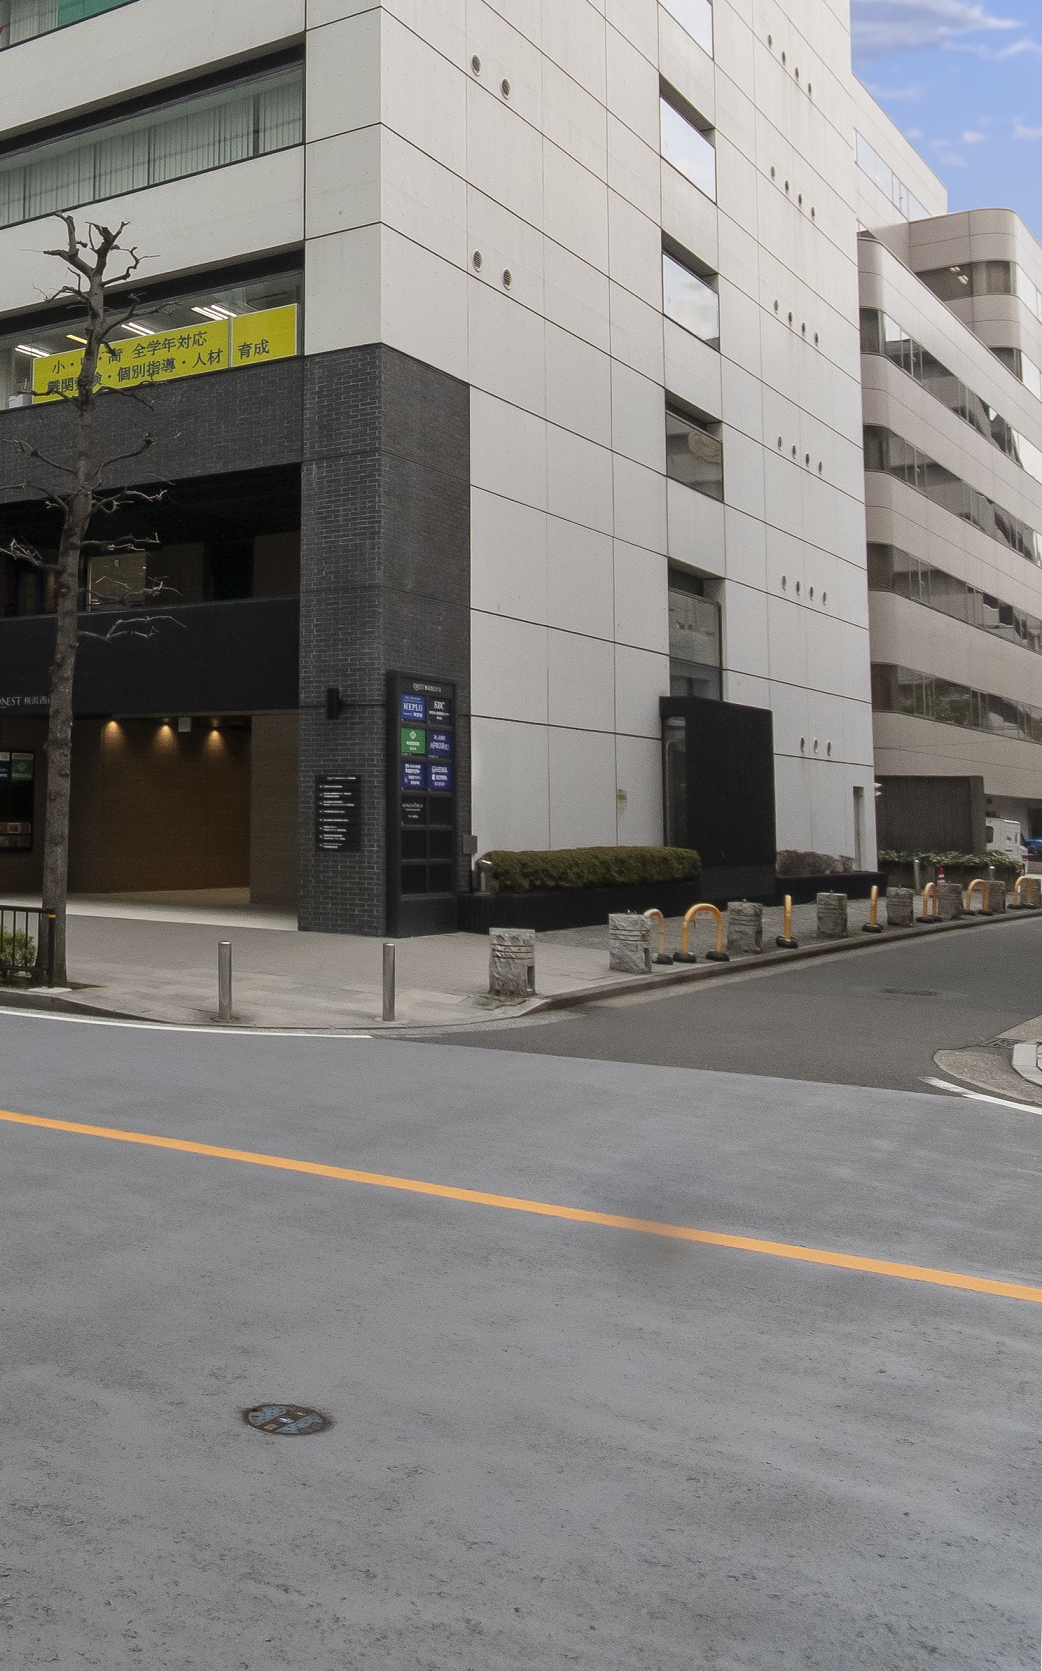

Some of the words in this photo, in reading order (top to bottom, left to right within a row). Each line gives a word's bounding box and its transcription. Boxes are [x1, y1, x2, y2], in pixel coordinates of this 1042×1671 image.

[132, 331, 207, 359] 全学年対応
